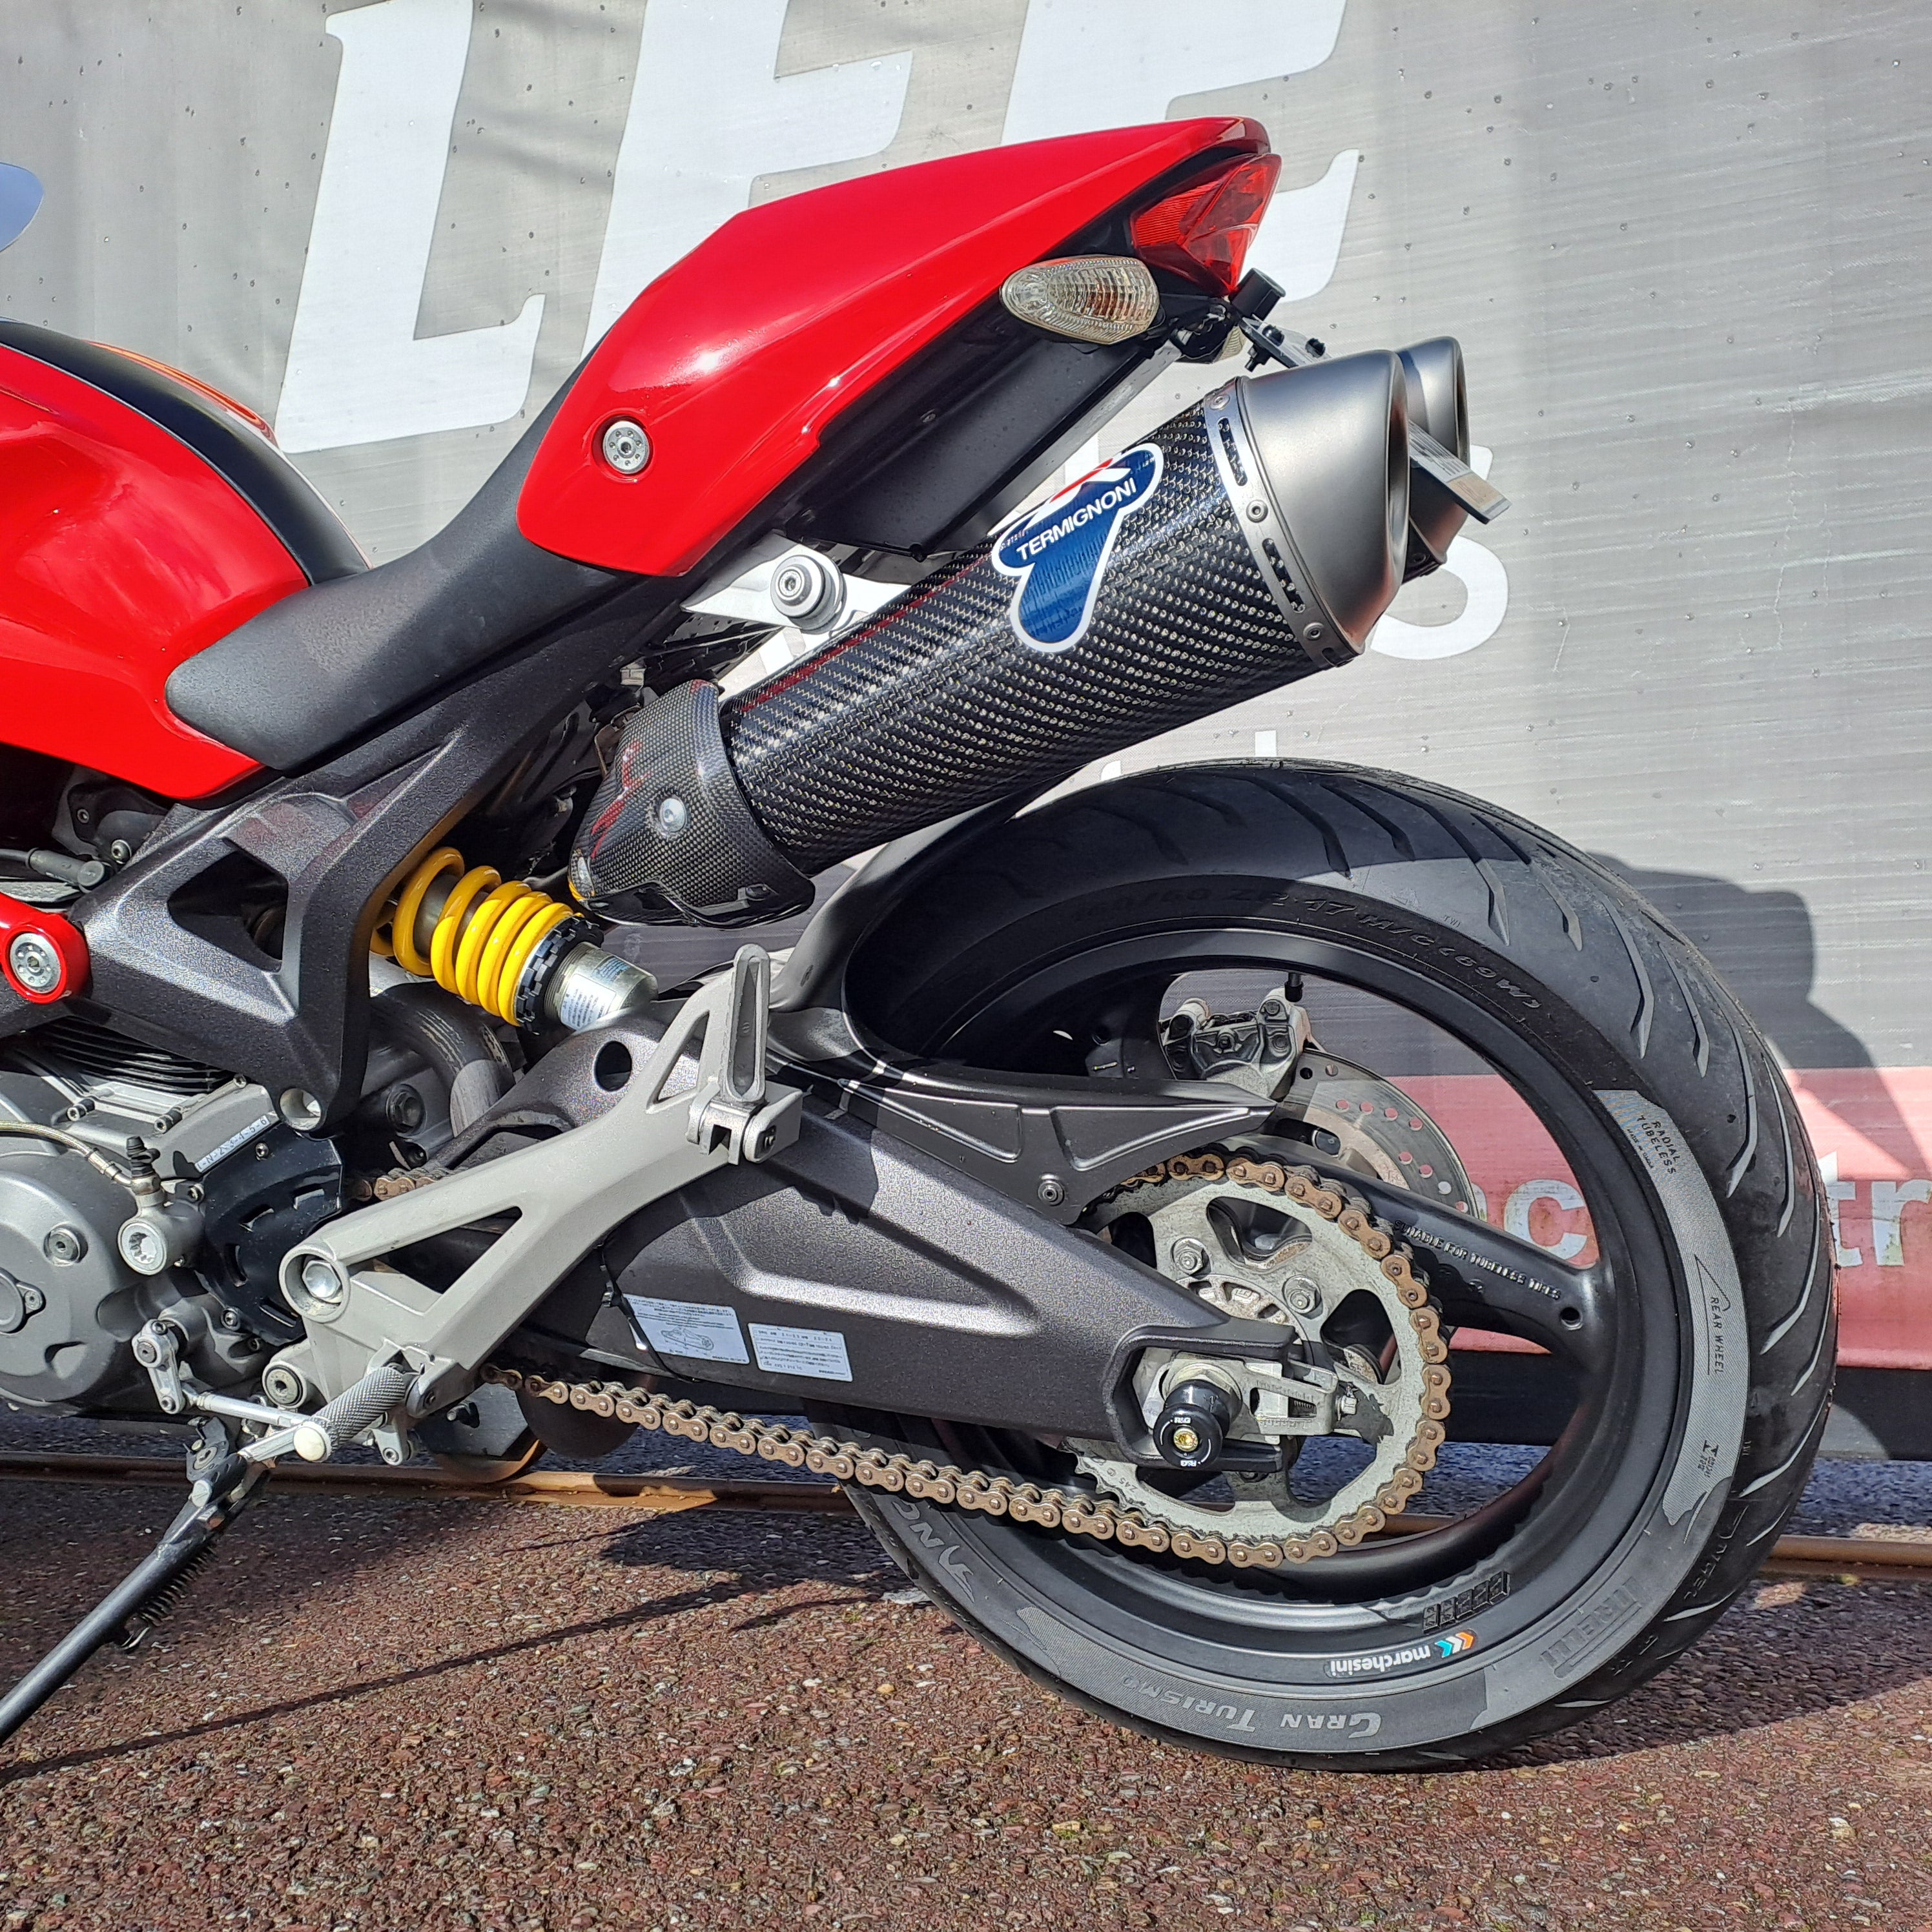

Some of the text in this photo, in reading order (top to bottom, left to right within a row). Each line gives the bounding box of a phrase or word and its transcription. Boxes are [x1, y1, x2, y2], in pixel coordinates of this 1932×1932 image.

[1016, 477, 1137, 560] TERMIGNONI
[1636, 1114, 1676, 1175] TUBELESS
[1651, 1120, 1681, 1163] RADIAL
[1393, 1220, 1444, 1249] SUITABLE
[1443, 1241, 1468, 1260] FOR
[1470, 1251, 1526, 1286] TUBELESS
[1711, 1296, 1725, 1375] REAR WHEEL
[1118, 1477, 1135, 1492] Z45
[1540, 1576, 1646, 1679] PIRELLI
[1330, 1644, 1431, 1677] marchesini
[1122, 1675, 1382, 1739] GRAN TURISMO
